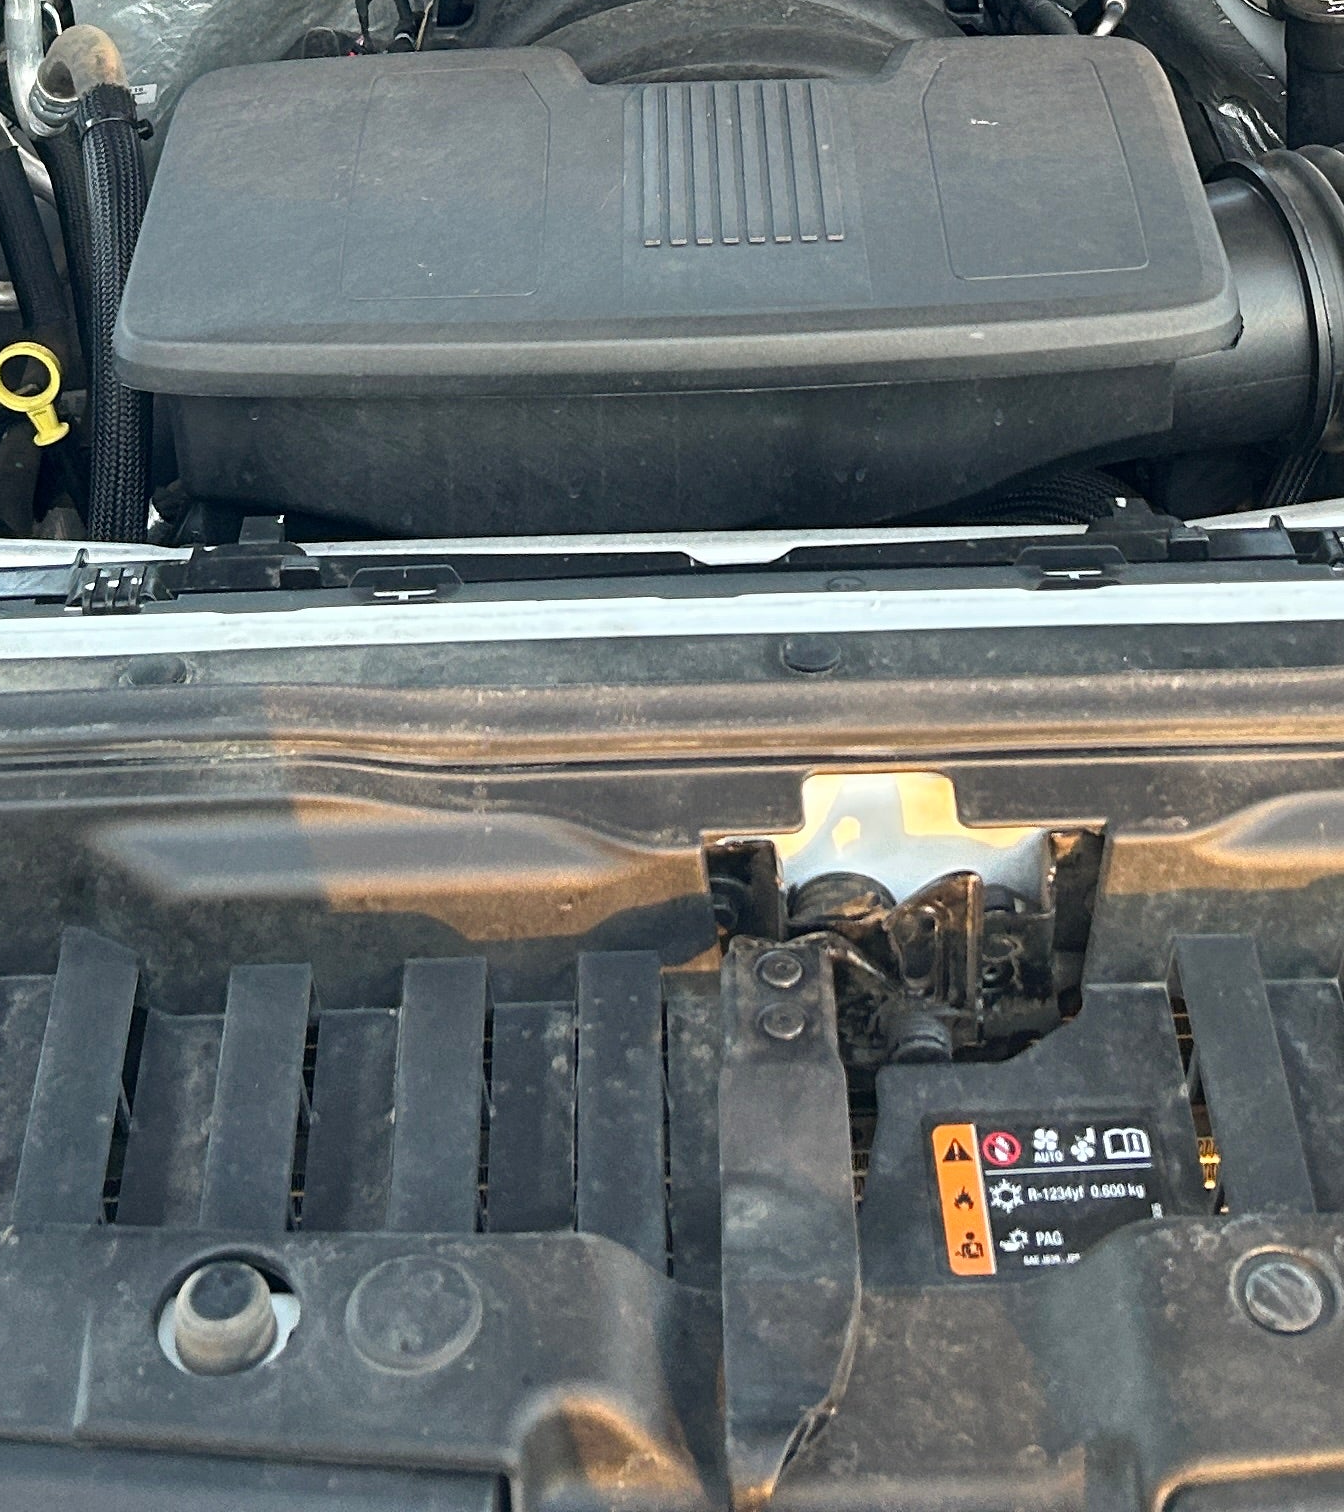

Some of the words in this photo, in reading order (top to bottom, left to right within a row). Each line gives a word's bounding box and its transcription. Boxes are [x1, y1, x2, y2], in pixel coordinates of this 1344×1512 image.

[1034, 1151, 1064, 1163] AUTO
[1027, 1185, 1084, 1202] R-1234yf
[1090, 1183, 1125, 1199] 0.600
[1127, 1183, 1146, 1199] kg
[1036, 1230, 1064, 1247] PAG
